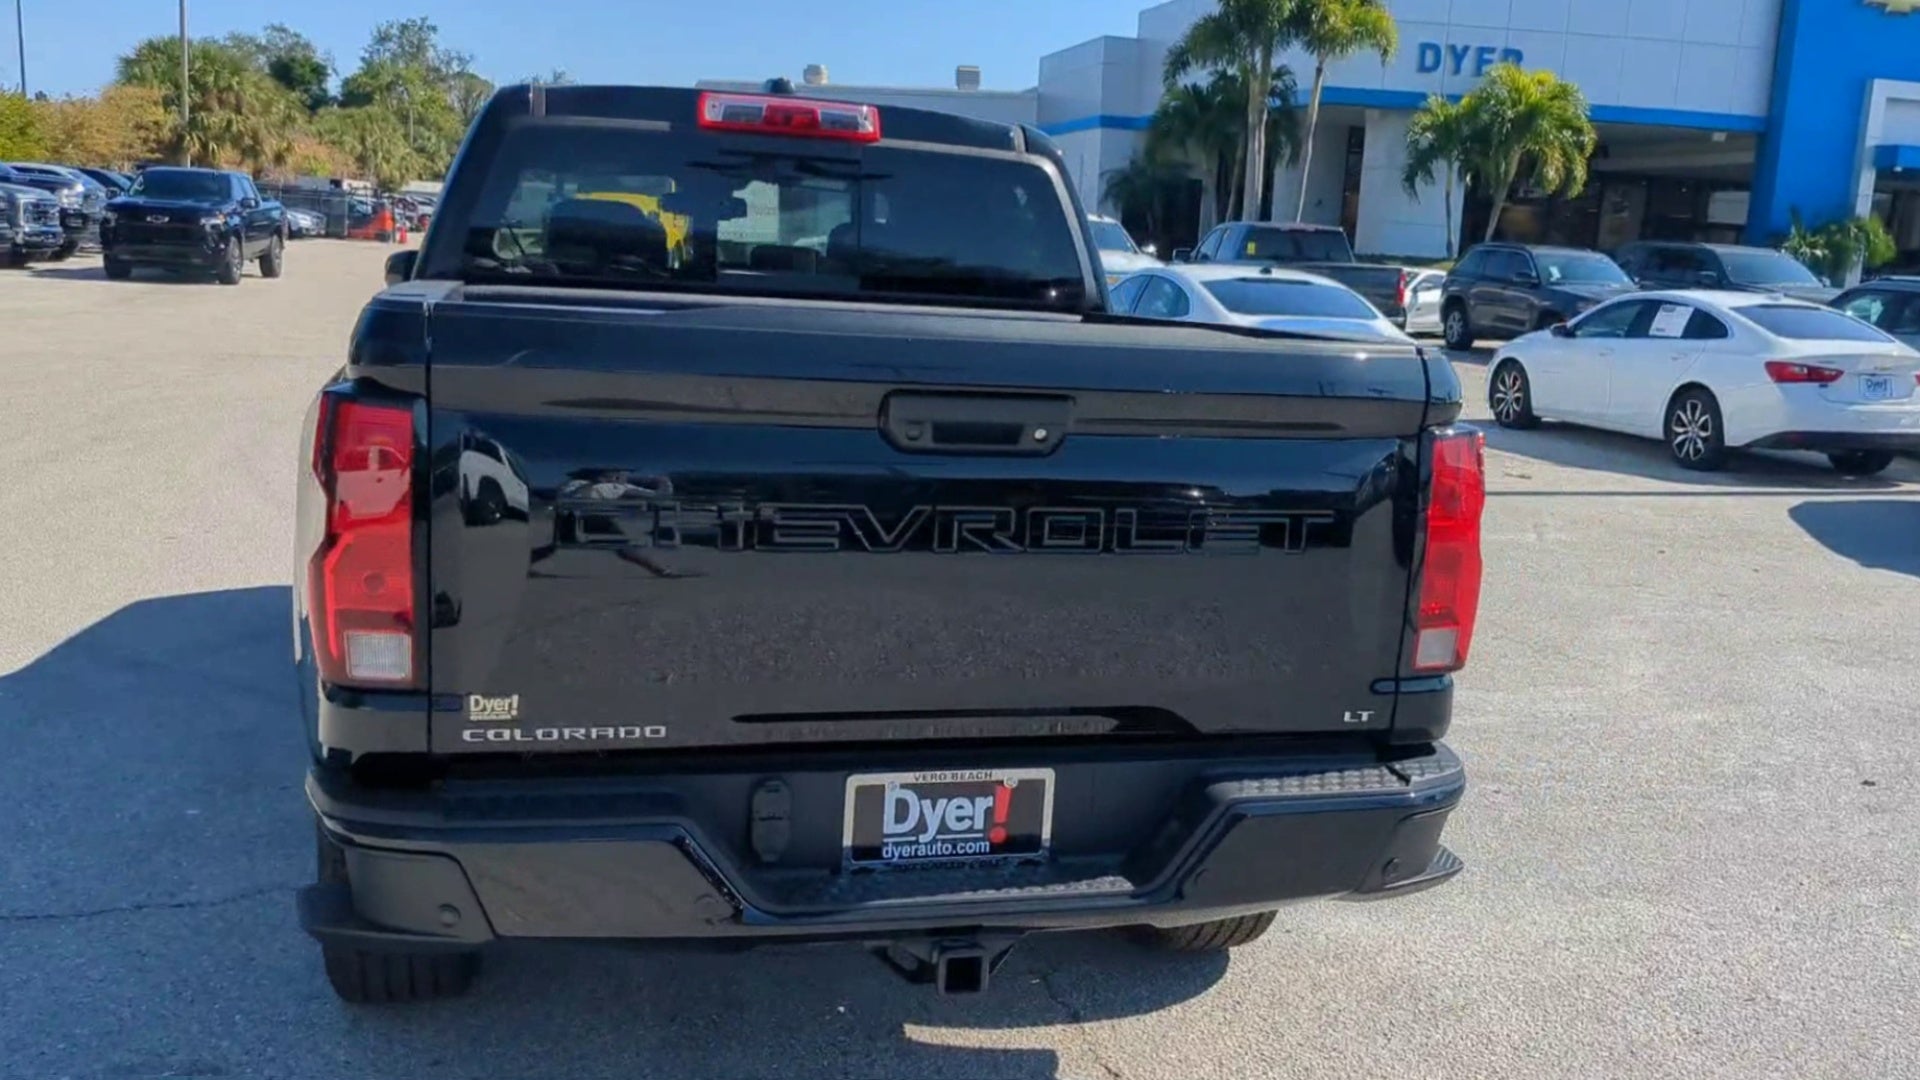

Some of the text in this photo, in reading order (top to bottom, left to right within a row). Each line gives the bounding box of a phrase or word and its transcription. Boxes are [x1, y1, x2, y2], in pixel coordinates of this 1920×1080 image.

[557, 502, 1334, 555] CHEVROLET
[470, 694, 519, 716] Dyer!
[1344, 710, 1375, 722] LT
[462, 725, 667, 742] COLORADO
[951, 772, 993, 781] BEACH
[882, 785, 1012, 843] Dyer!
[882, 841, 991, 860] dyerauto.com
